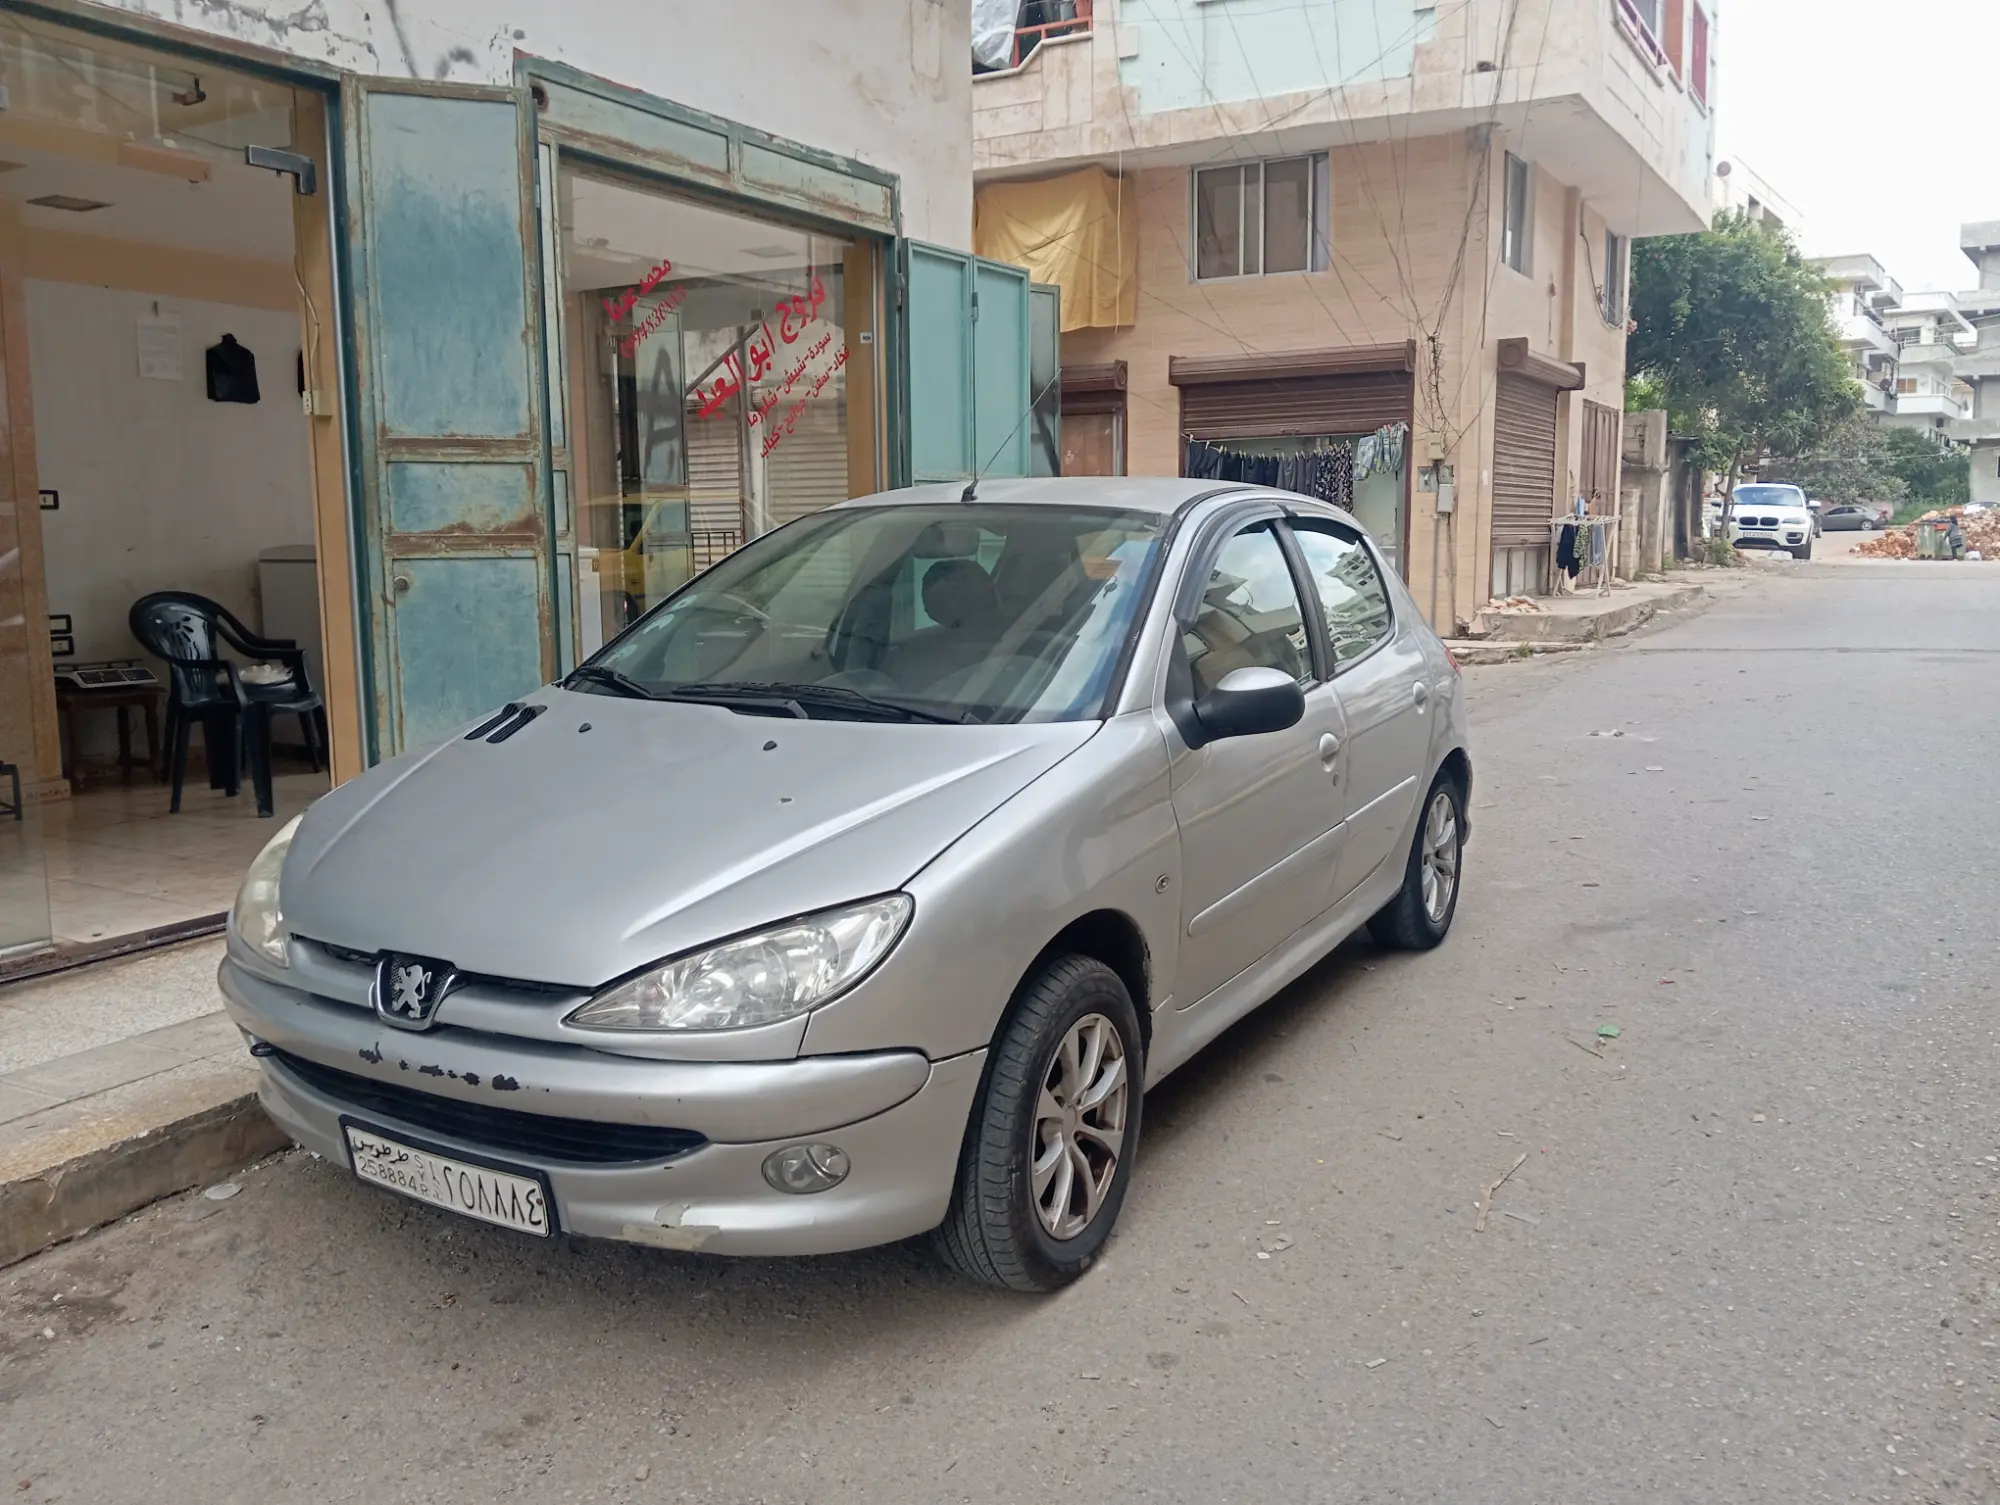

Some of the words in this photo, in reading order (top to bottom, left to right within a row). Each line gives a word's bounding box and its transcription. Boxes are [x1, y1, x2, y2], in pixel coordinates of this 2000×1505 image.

[775, 265, 826, 344] فروج
[748, 319, 776, 381] ابو
[358, 1155, 418, 1193] 258884
[443, 1165, 542, 1226] ٢٥٨٨٨٤
